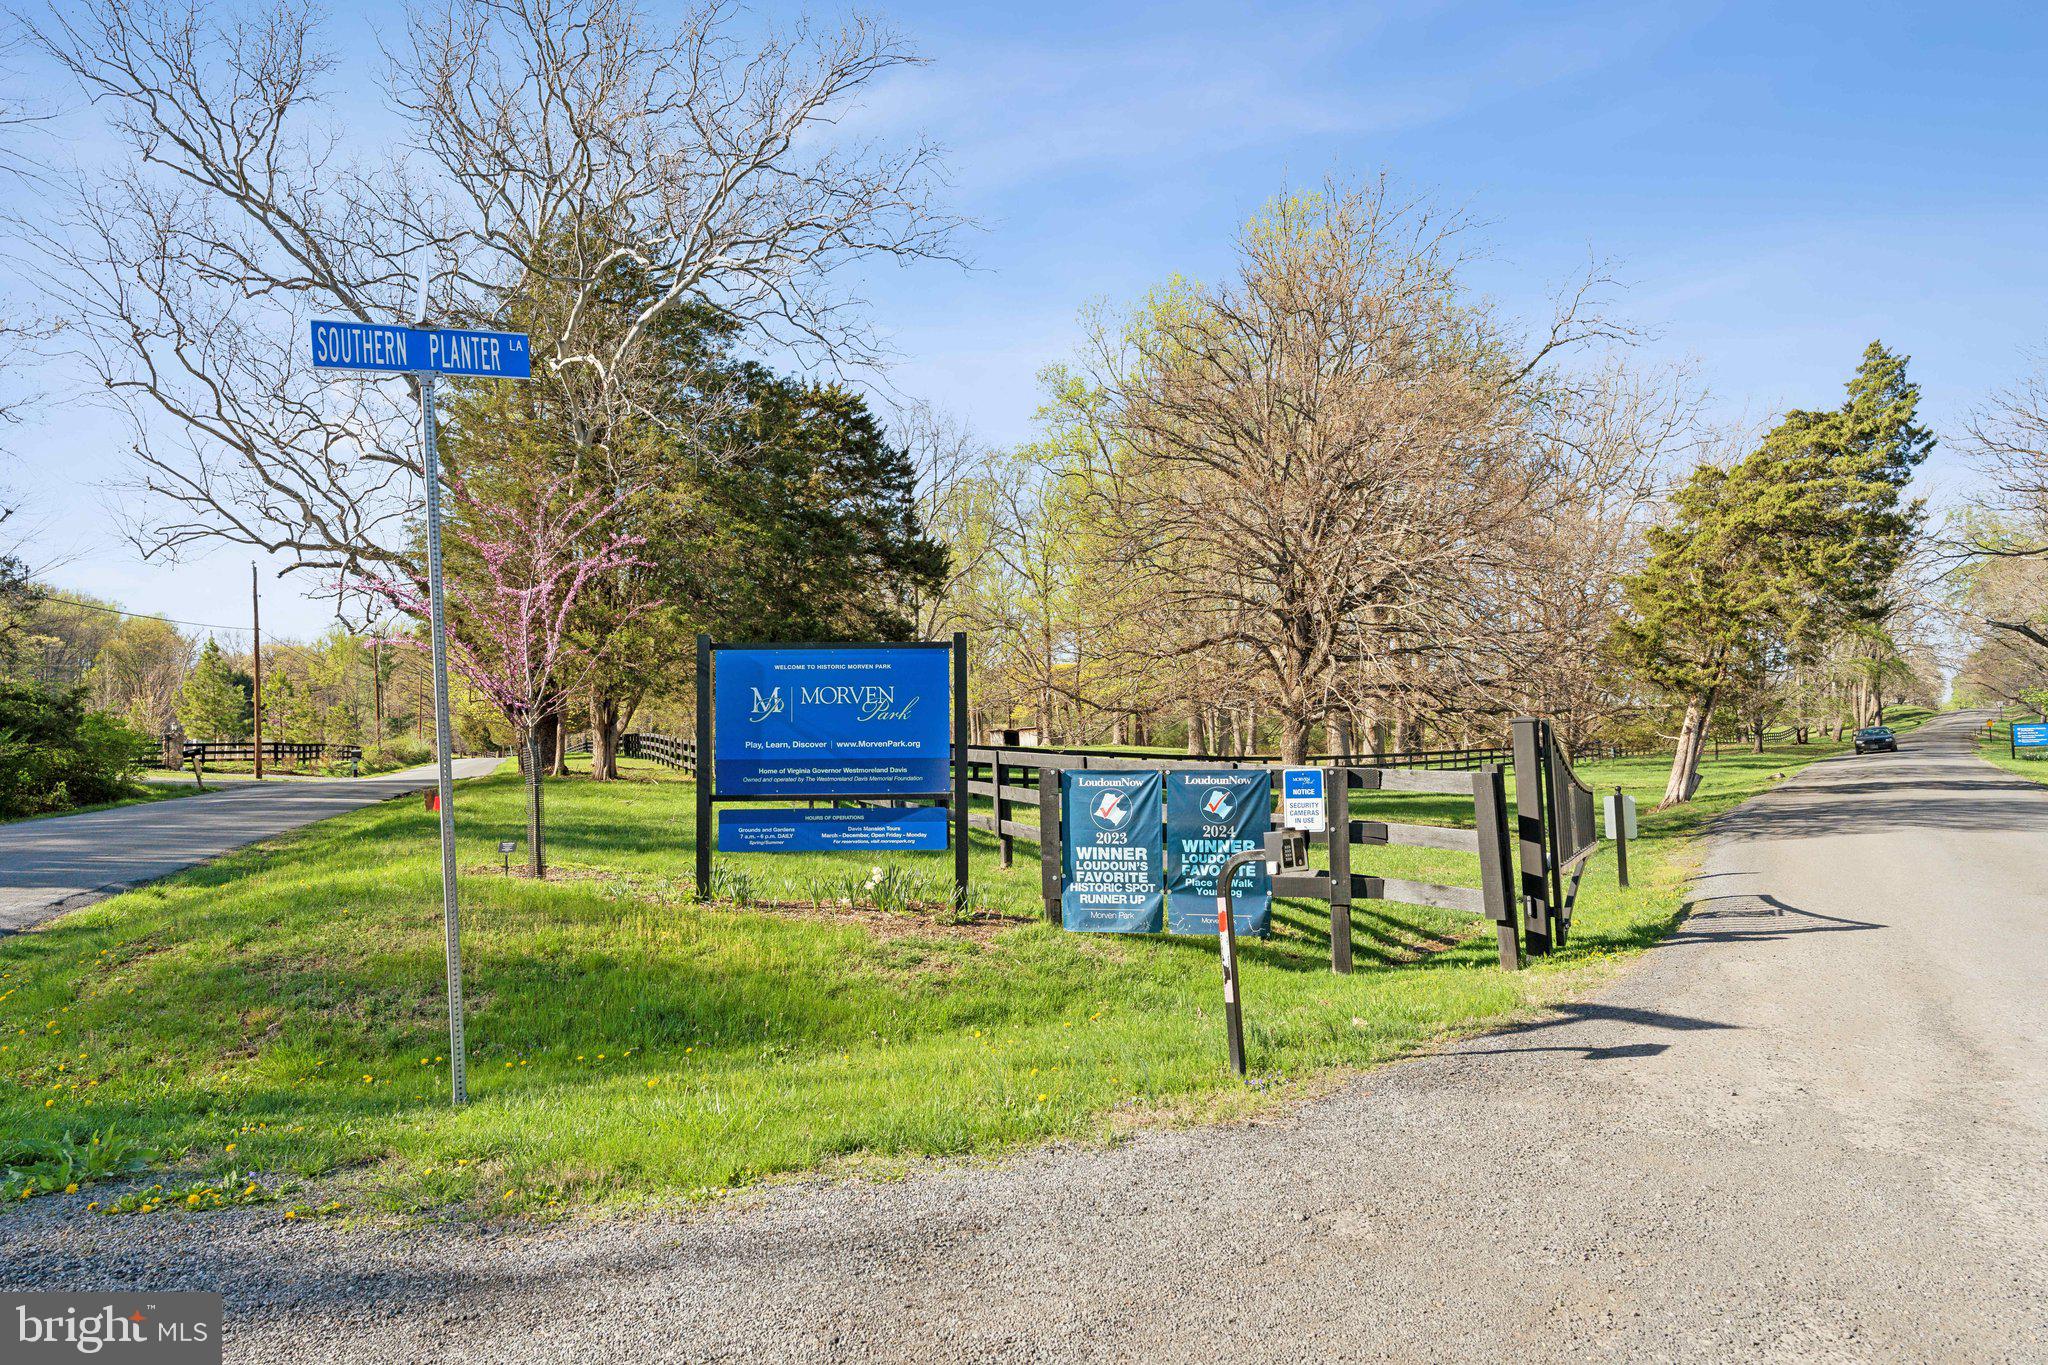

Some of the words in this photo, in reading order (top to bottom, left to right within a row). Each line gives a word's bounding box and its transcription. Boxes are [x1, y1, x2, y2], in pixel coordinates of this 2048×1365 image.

[317, 326, 407, 365] SOUTHERN
[430, 334, 501, 370] PLANTER
[509, 340, 523, 352] LA
[800, 686, 895, 705] MORVEN
[857, 696, 920, 722] Park
[745, 741, 764, 750] Play,
[766, 741, 790, 749] Learn,
[836, 740, 920, 749] www.MorvenPark.org
[1078, 778, 1144, 786] LoudounNow
[1185, 776, 1252, 785] LoudounNow
[1203, 825, 1236, 837] 2024
[1096, 832, 1128, 844] 2023
[1182, 840, 1255, 853] WINNER
[1076, 847, 1147, 860] WINNER
[1182, 854, 1255, 864] LOUDO
[1076, 861, 1148, 871] LOUDOUN'S
[1182, 864, 1256, 876] FAVOTE
[1076, 872, 1148, 883] FAVORITE
[1185, 878, 1213, 887] Place
[1070, 883, 1122, 892] HISTORIC
[1125, 883, 1155, 892] SPOT
[1080, 894, 1129, 904] RUNNER
[1130, 895, 1146, 904] UP
[1231, 890, 1242, 898] og
